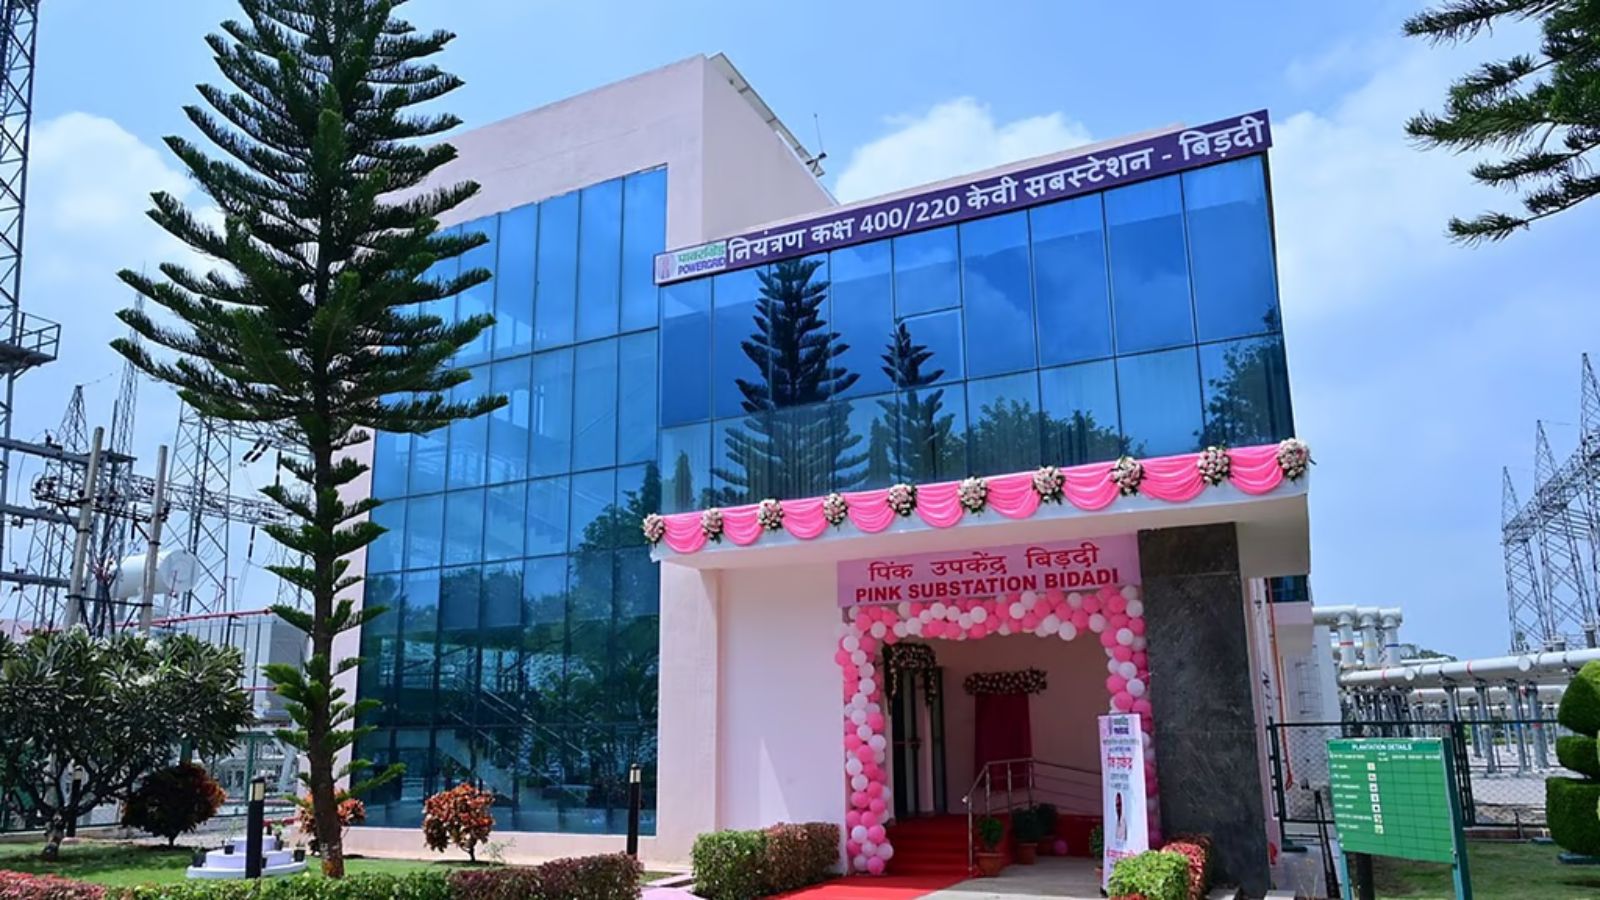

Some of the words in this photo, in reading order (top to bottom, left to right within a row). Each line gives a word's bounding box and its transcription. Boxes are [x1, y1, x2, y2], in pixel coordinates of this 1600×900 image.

[728, 228, 806, 263] नियंत्रण
[811, 218, 855, 244] कक्ष
[861, 198, 960, 234] 400/220
[966, 176, 1018, 210] केवी
[1024, 147, 1154, 197] सबस्टेशन
[1179, 116, 1265, 160] बिड़दी
[678, 256, 725, 275] POWERGRID
[869, 561, 914, 581] पिंक
[929, 551, 1007, 575] उपकेंद्र
[1025, 542, 1099, 569] बिड़दी
[855, 585, 902, 602] PINK
[908, 574, 1036, 599] SUBSTATION
[1045, 568, 1118, 588] BIDADI
